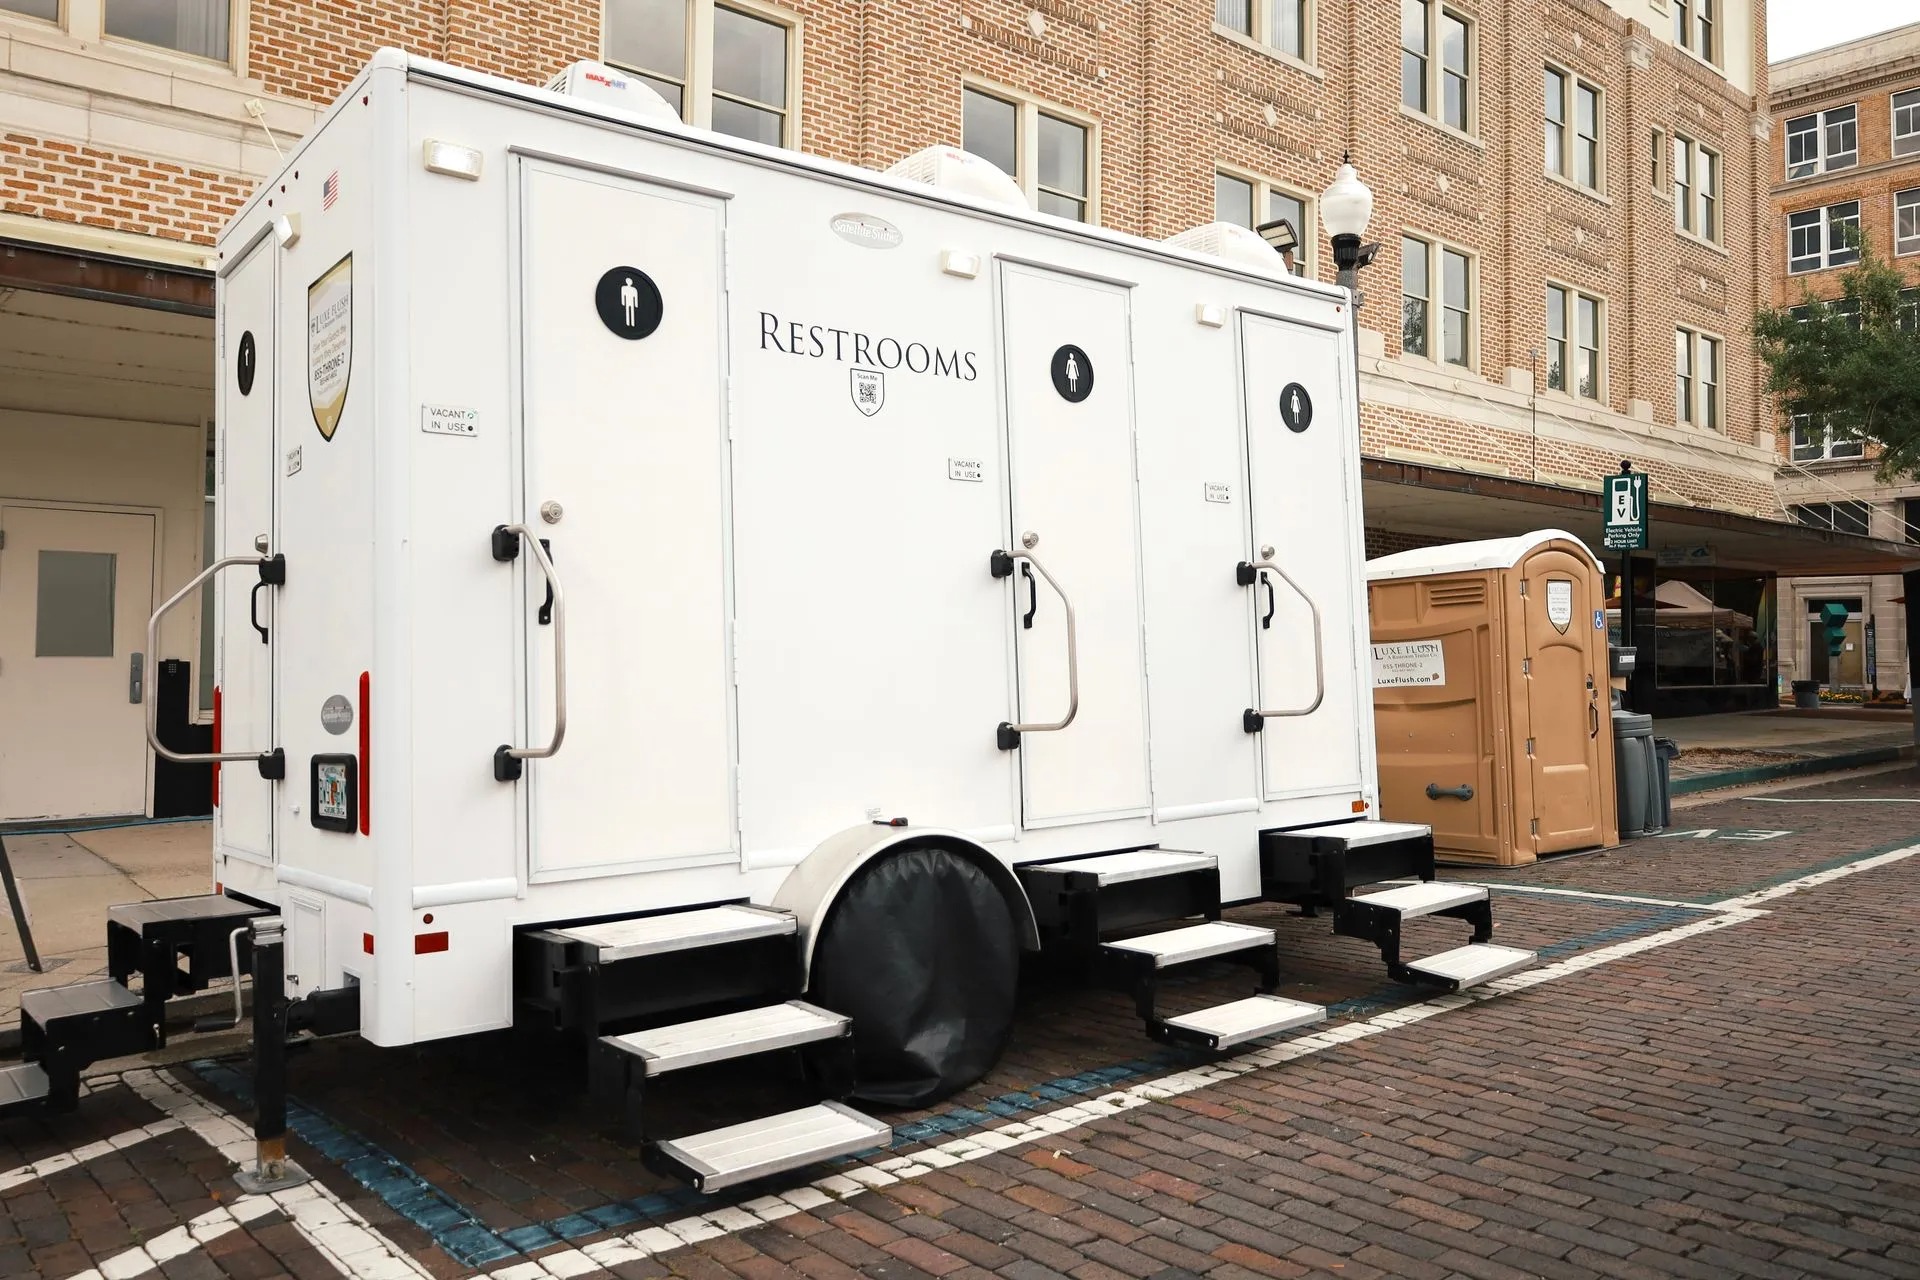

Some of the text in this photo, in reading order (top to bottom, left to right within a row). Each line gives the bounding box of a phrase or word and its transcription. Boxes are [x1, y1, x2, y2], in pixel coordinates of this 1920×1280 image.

[757, 311, 977, 381] RESTROOMS
[430, 408, 466, 419] VACANT
[431, 421, 466, 432] IN USE
[953, 460, 976, 468] VACANT
[964, 470, 976, 478] USE
[1374, 644, 1438, 660] LUXE FLUSH
[1377, 676, 1431, 684] LuxeFlush.com
